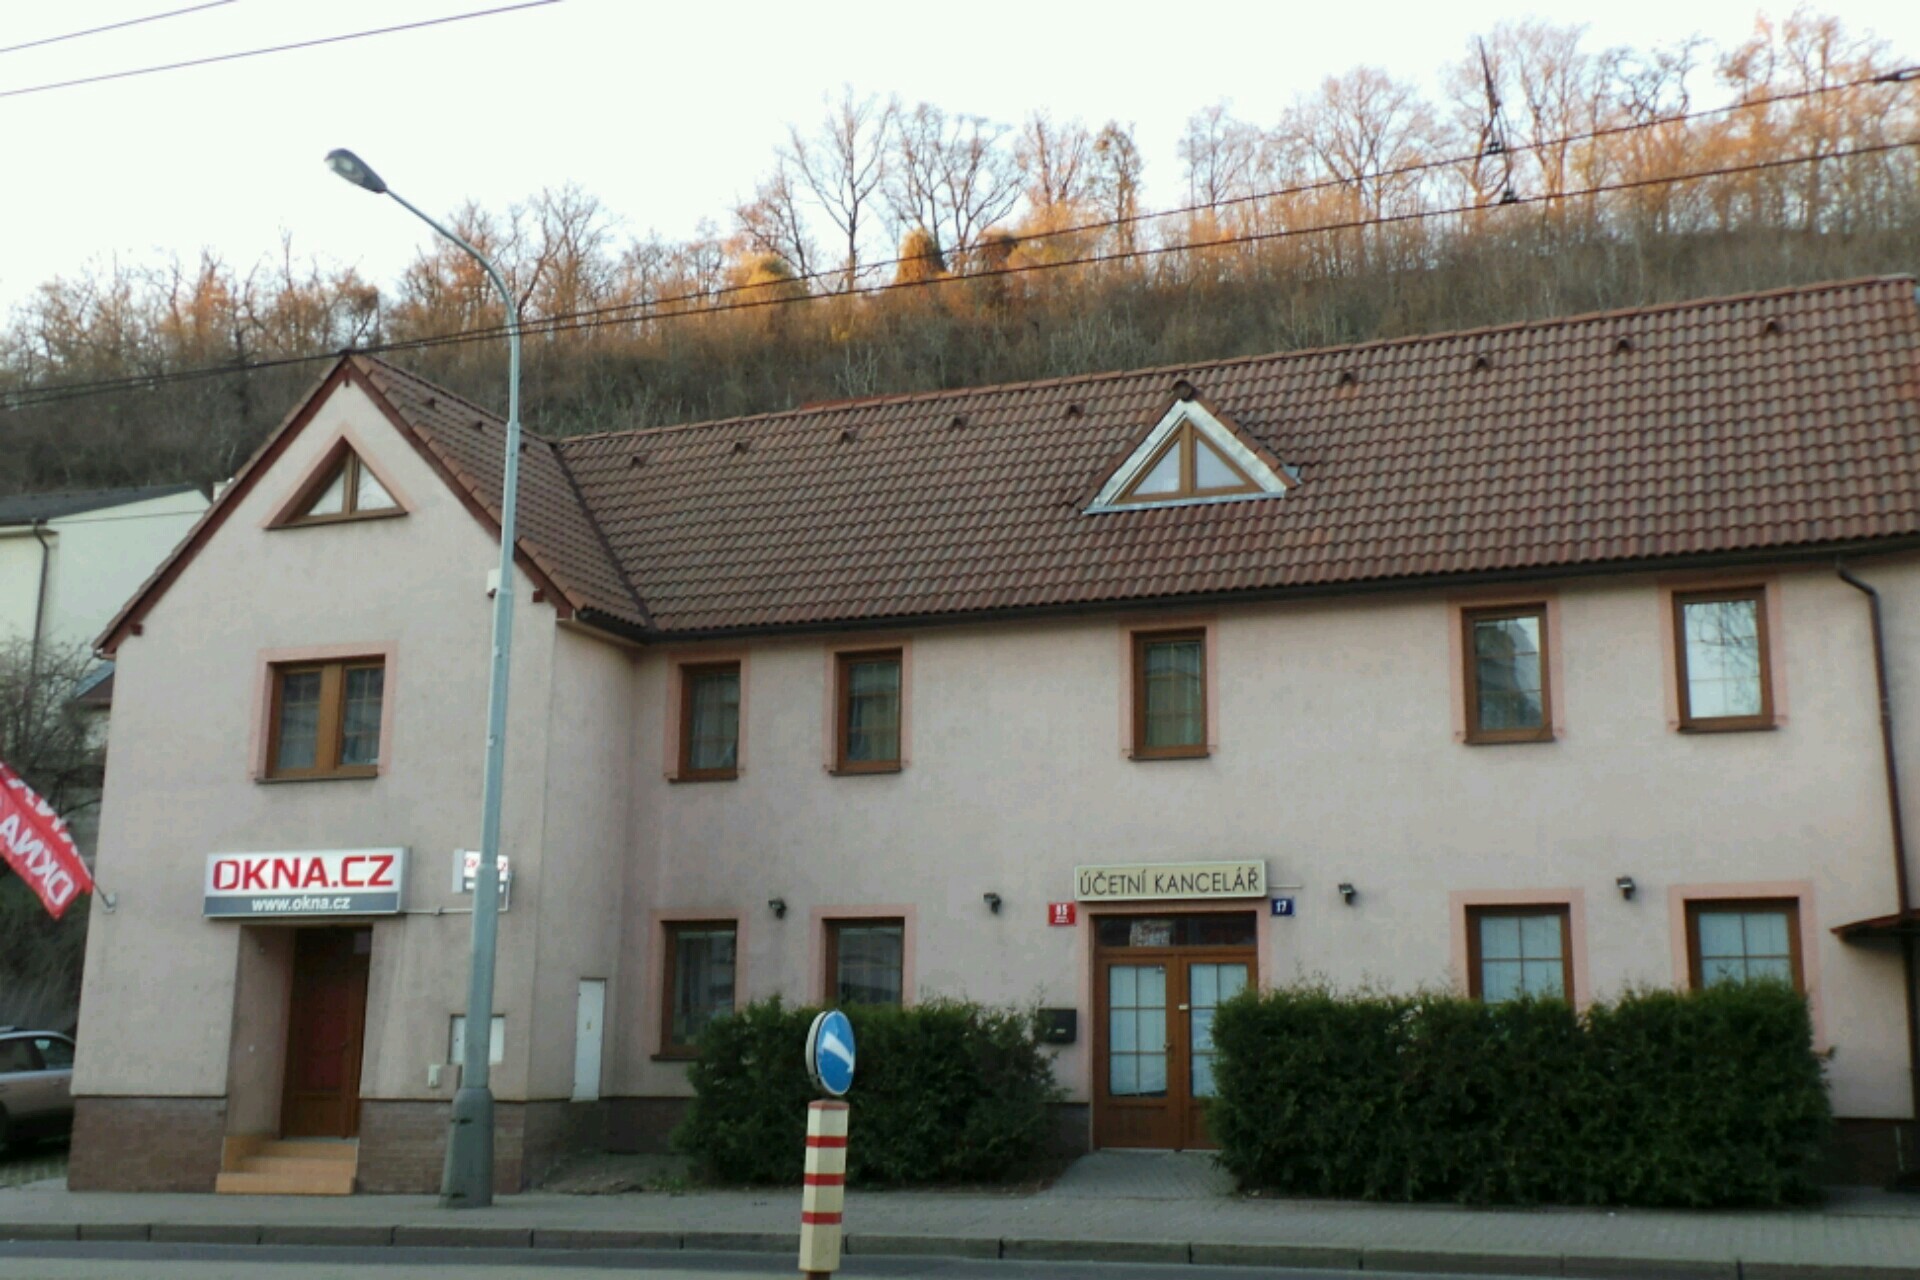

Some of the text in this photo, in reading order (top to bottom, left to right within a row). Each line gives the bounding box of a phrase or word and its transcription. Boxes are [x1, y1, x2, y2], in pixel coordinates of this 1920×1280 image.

[212, 855, 394, 890] OKNA.CZ
[1080, 866, 1259, 895] ÚČETNÍ KANCELÁŘ
[252, 896, 350, 911] www.okna.cz
